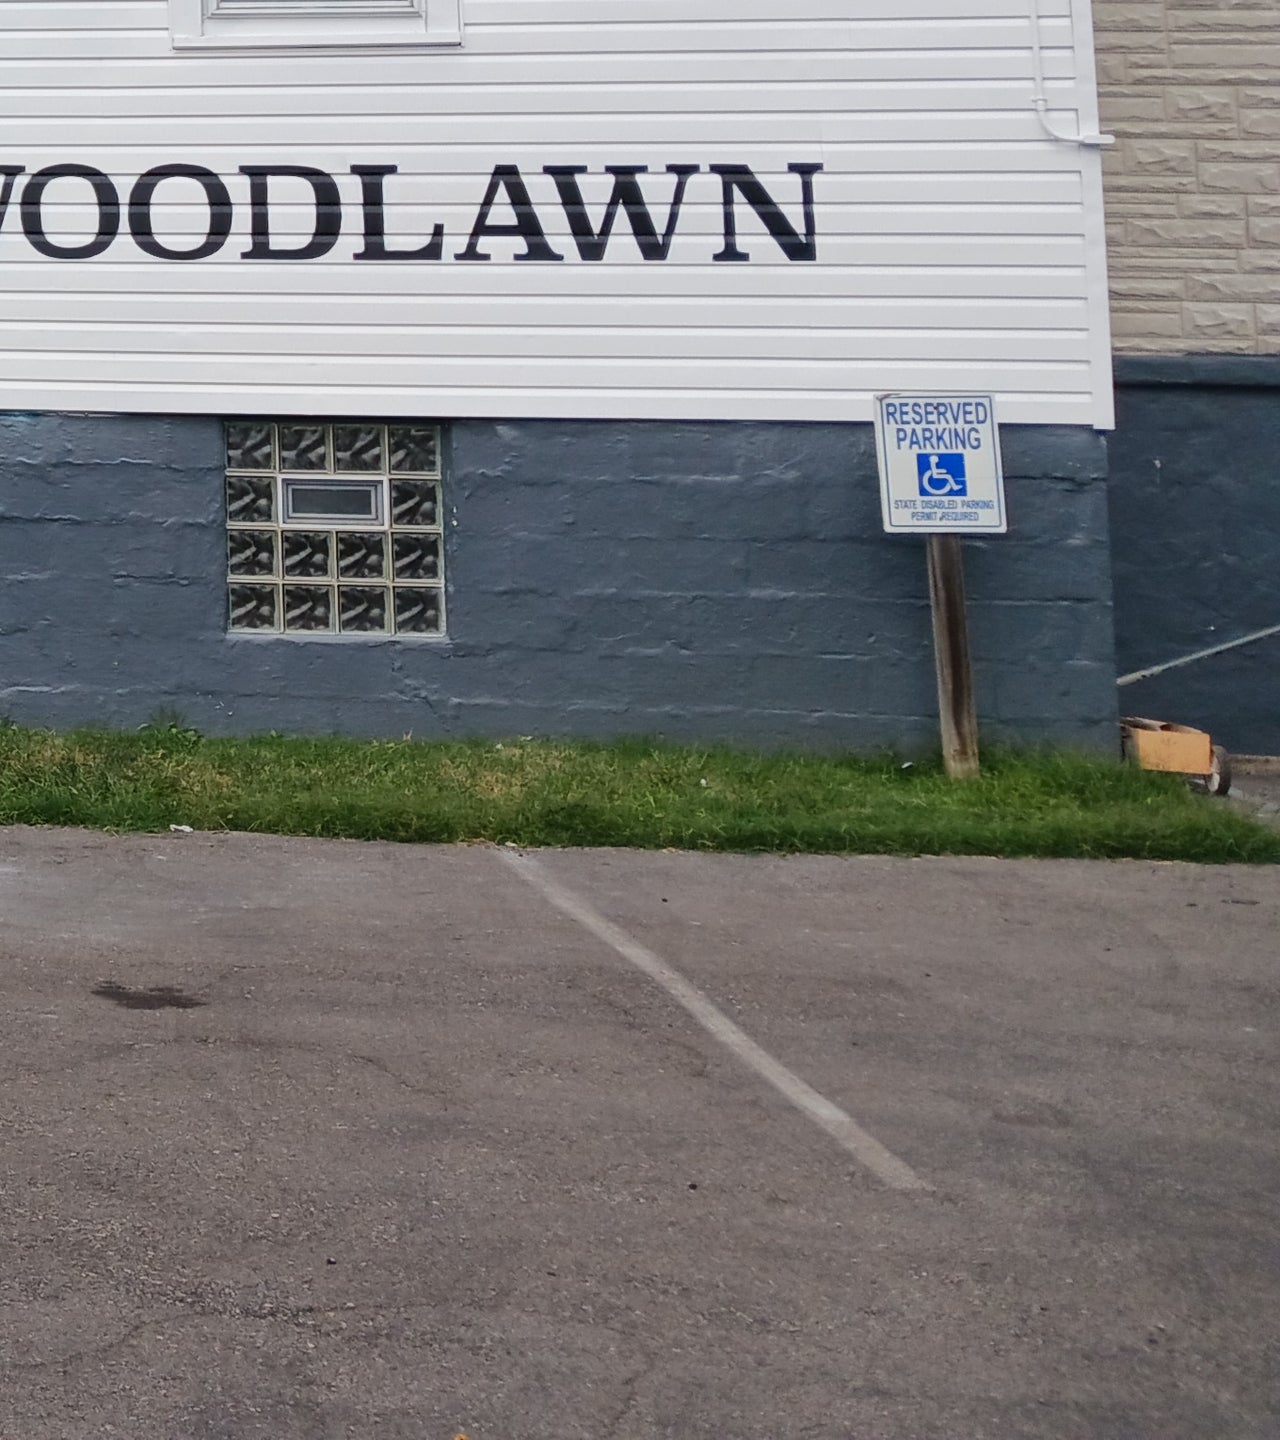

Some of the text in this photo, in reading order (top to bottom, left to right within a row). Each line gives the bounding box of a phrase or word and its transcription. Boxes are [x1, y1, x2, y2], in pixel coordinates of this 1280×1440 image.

[886, 402, 988, 425] RESERVED
[896, 427, 981, 450] PARKING
[894, 500, 994, 509] STATE DISABLED PARKING
[911, 512, 937, 521] PERMIT
